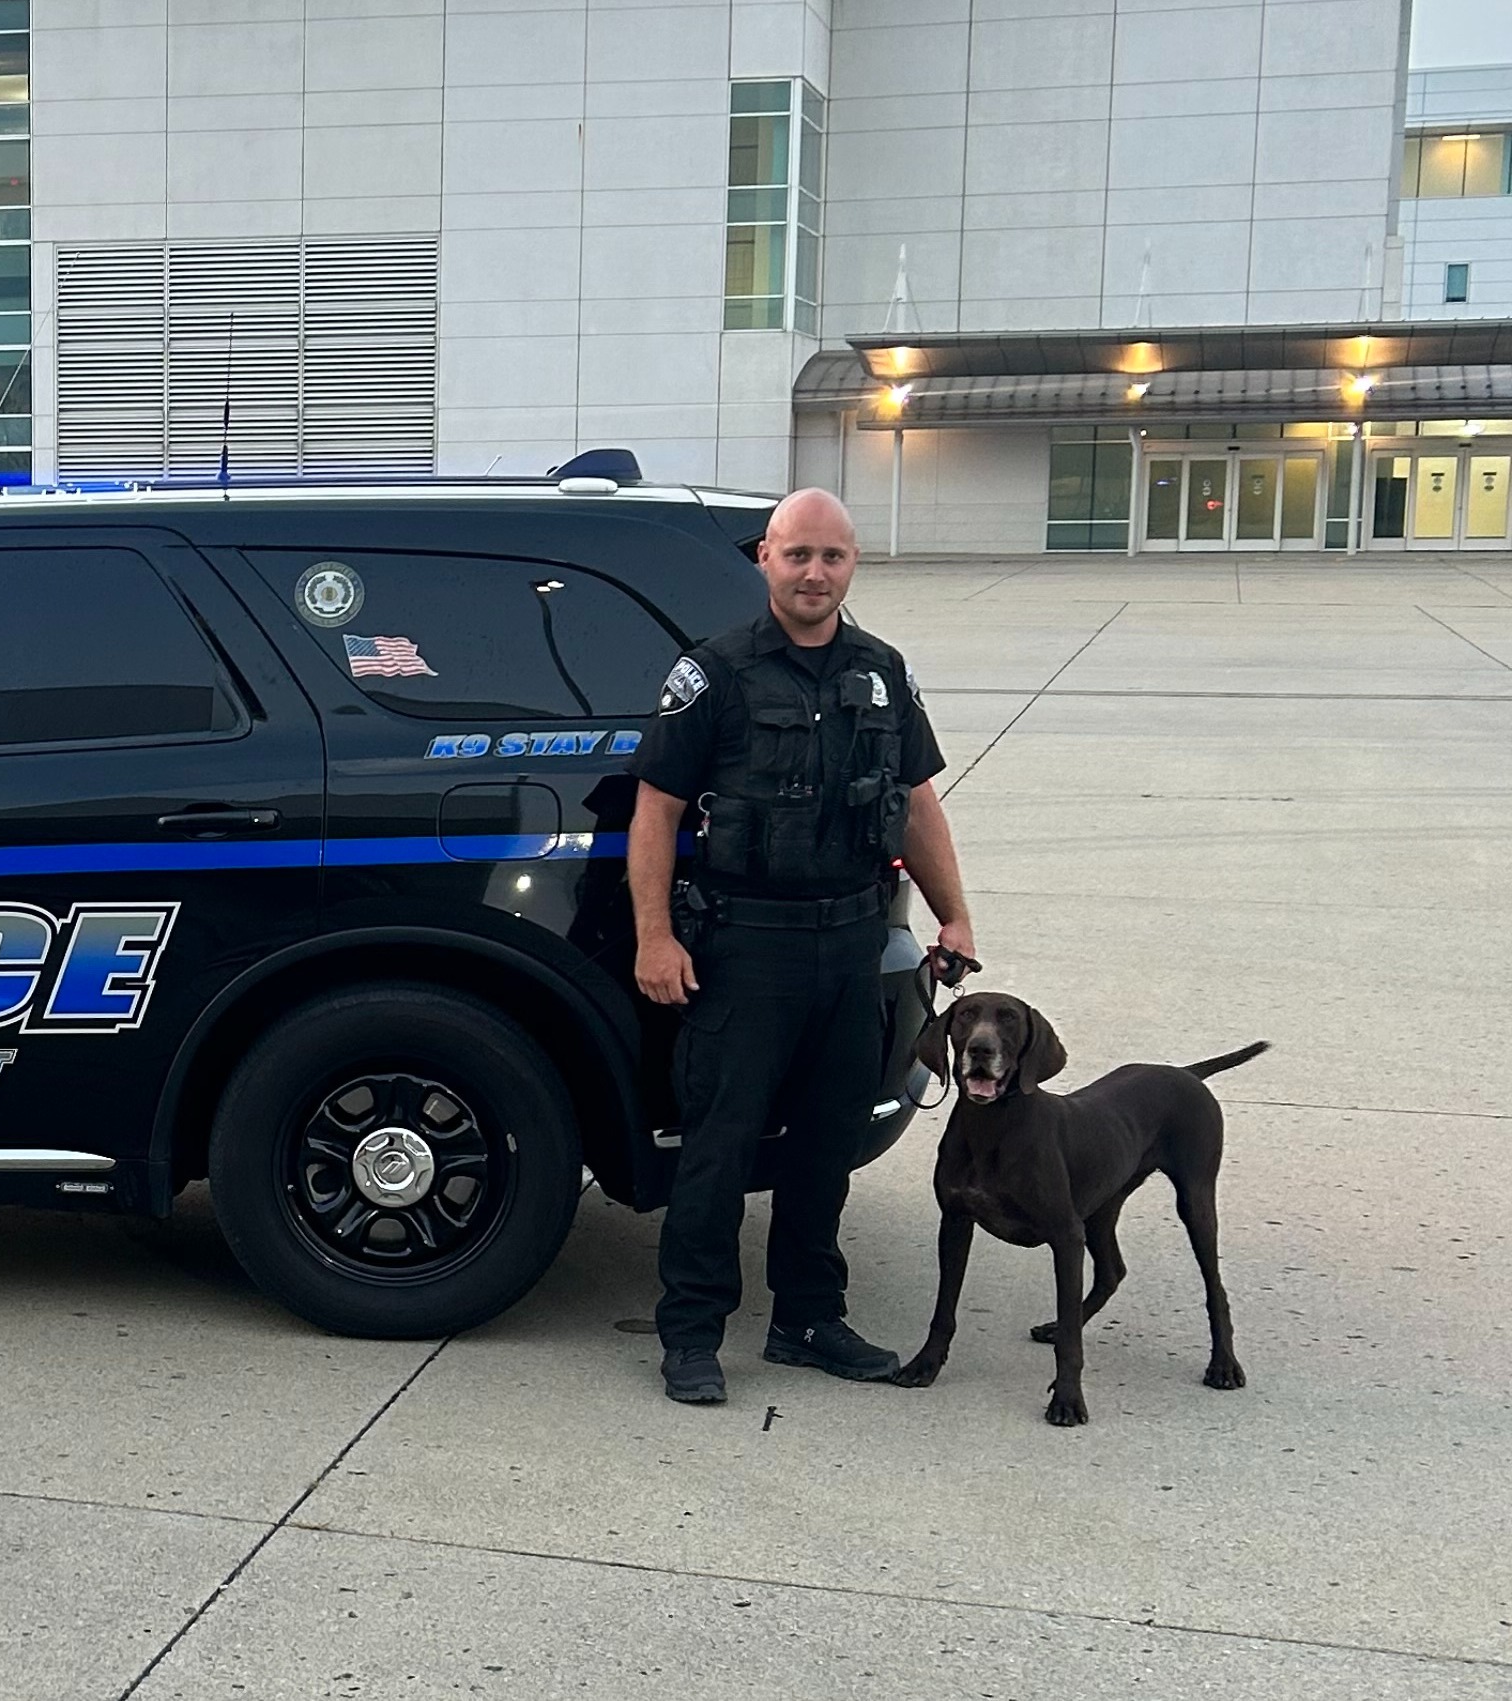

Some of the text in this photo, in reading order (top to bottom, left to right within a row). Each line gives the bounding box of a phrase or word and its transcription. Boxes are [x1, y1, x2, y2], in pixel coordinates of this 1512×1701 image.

[674, 660, 705, 692] POLICE
[423, 734, 492, 759] K9
[493, 731, 609, 757] STAY
